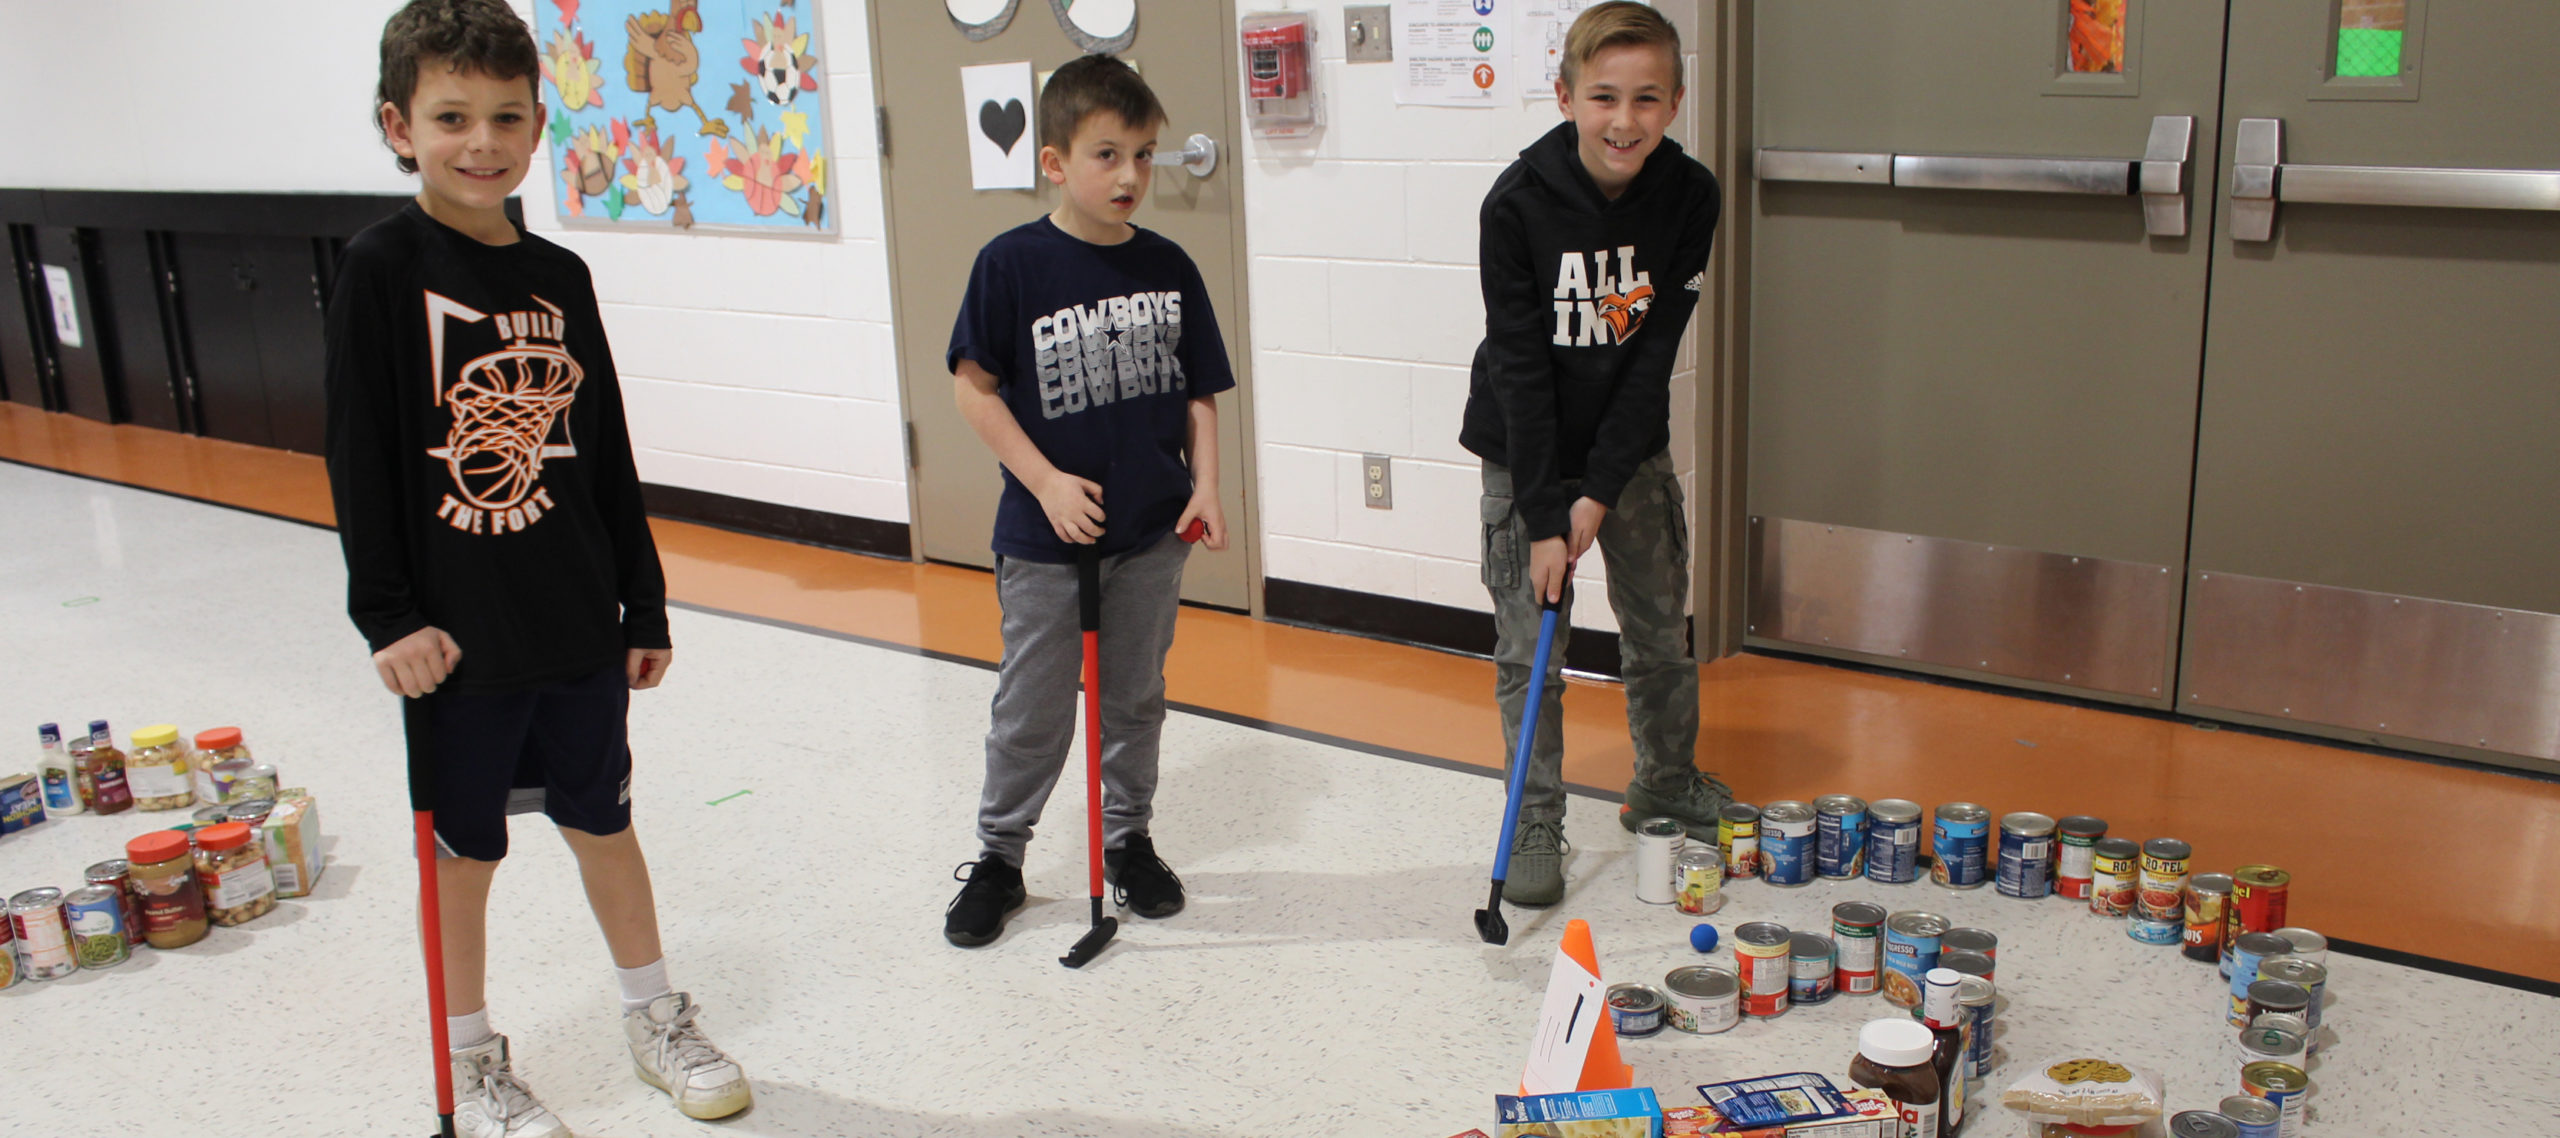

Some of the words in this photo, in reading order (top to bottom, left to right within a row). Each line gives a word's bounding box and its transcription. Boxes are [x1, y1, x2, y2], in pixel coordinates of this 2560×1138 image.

[1553, 245, 1652, 300] ALL
[493, 311, 565, 341] BUILD
[1032, 290, 1182, 350] COWBOYS
[436, 493, 483, 534] THE
[490, 486, 555, 535] FORT
